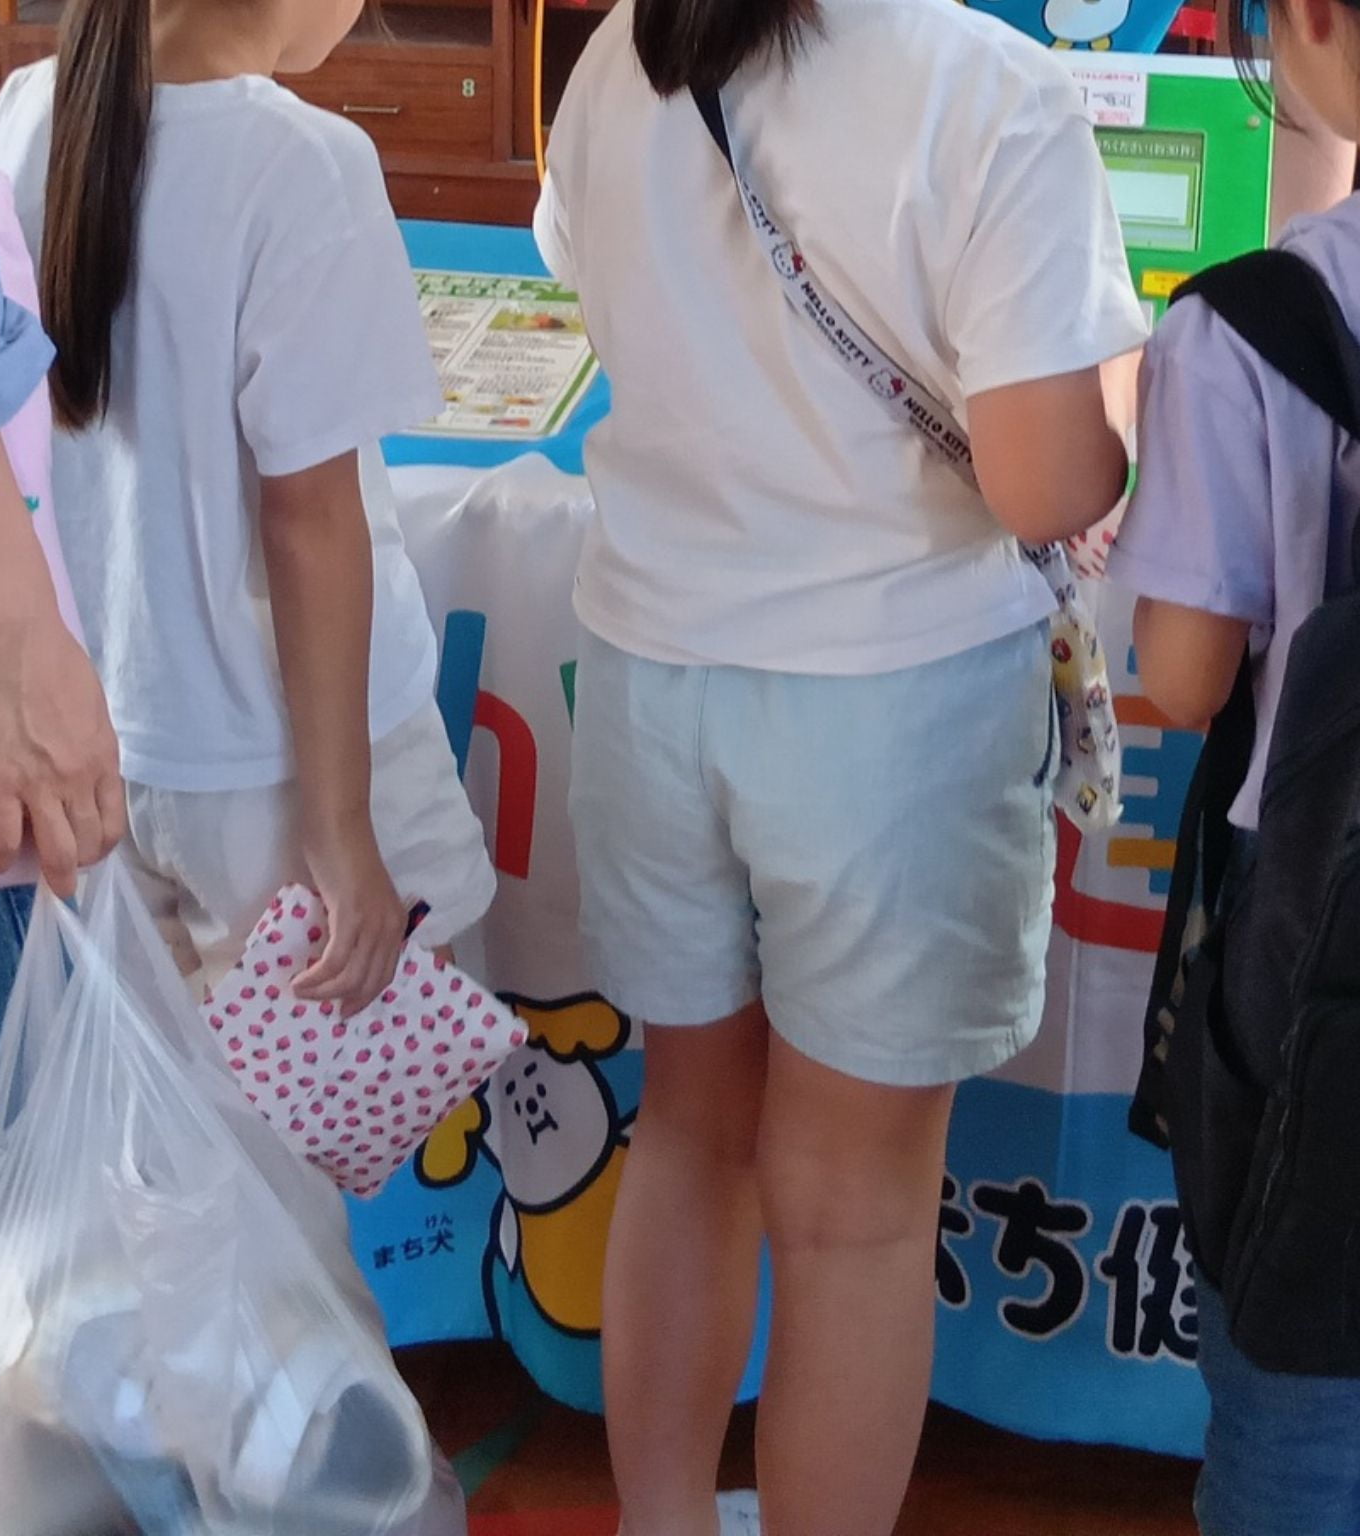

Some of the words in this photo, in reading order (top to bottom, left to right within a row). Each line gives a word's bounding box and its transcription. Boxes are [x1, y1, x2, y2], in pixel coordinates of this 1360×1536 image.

[462, 78, 475, 97] 8
[373, 1228, 457, 1269] まち犬
